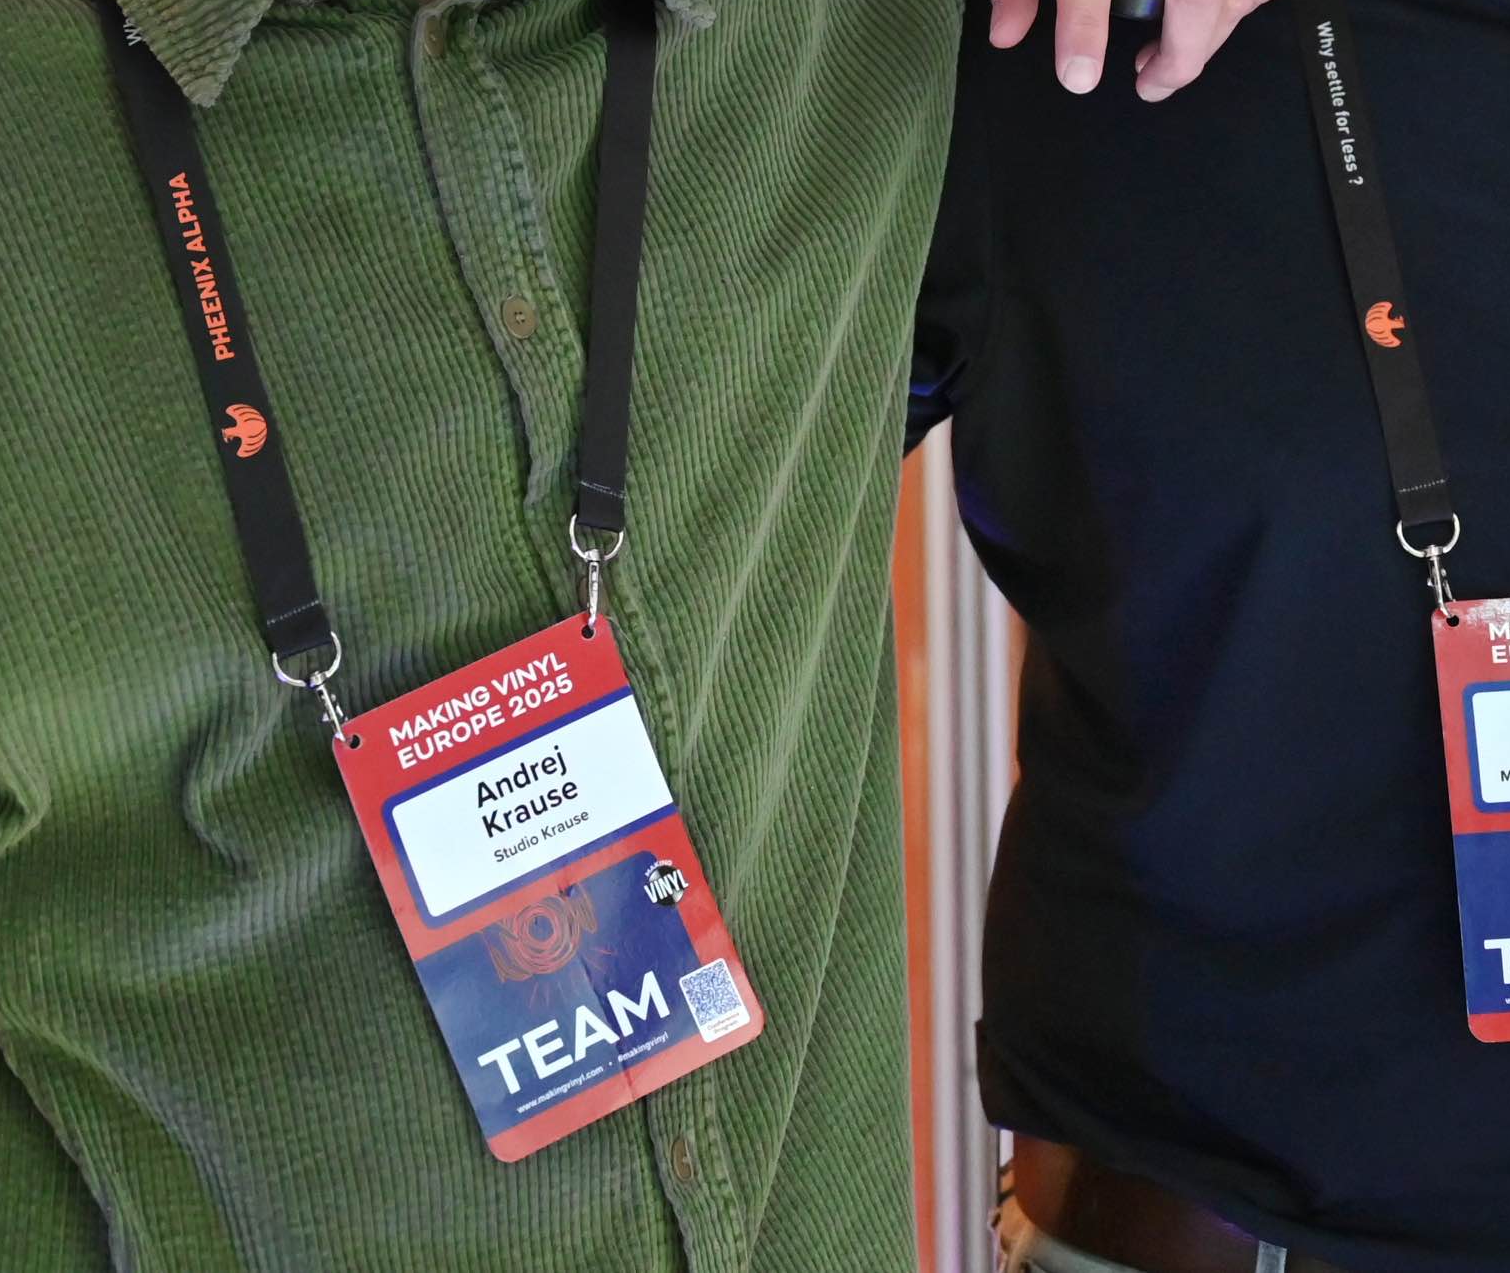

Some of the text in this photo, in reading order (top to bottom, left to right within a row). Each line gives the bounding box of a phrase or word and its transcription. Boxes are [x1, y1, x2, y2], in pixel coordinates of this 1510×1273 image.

[1317, 21, 1364, 186] Why settle for less ?
[169, 172, 235, 361] PHEENIX ALPHA
[388, 652, 567, 747] MAKING VINYL
[397, 673, 573, 770] EUROPE 2025
[477, 745, 567, 808] Andrej
[482, 781, 578, 838] Krause
[494, 811, 589, 862] Studio Krause
[644, 869, 689, 904] VINYL
[477, 970, 670, 1095] TEAM
[517, 1031, 669, 1114] www.makingvinyl.com #makingvinyl
